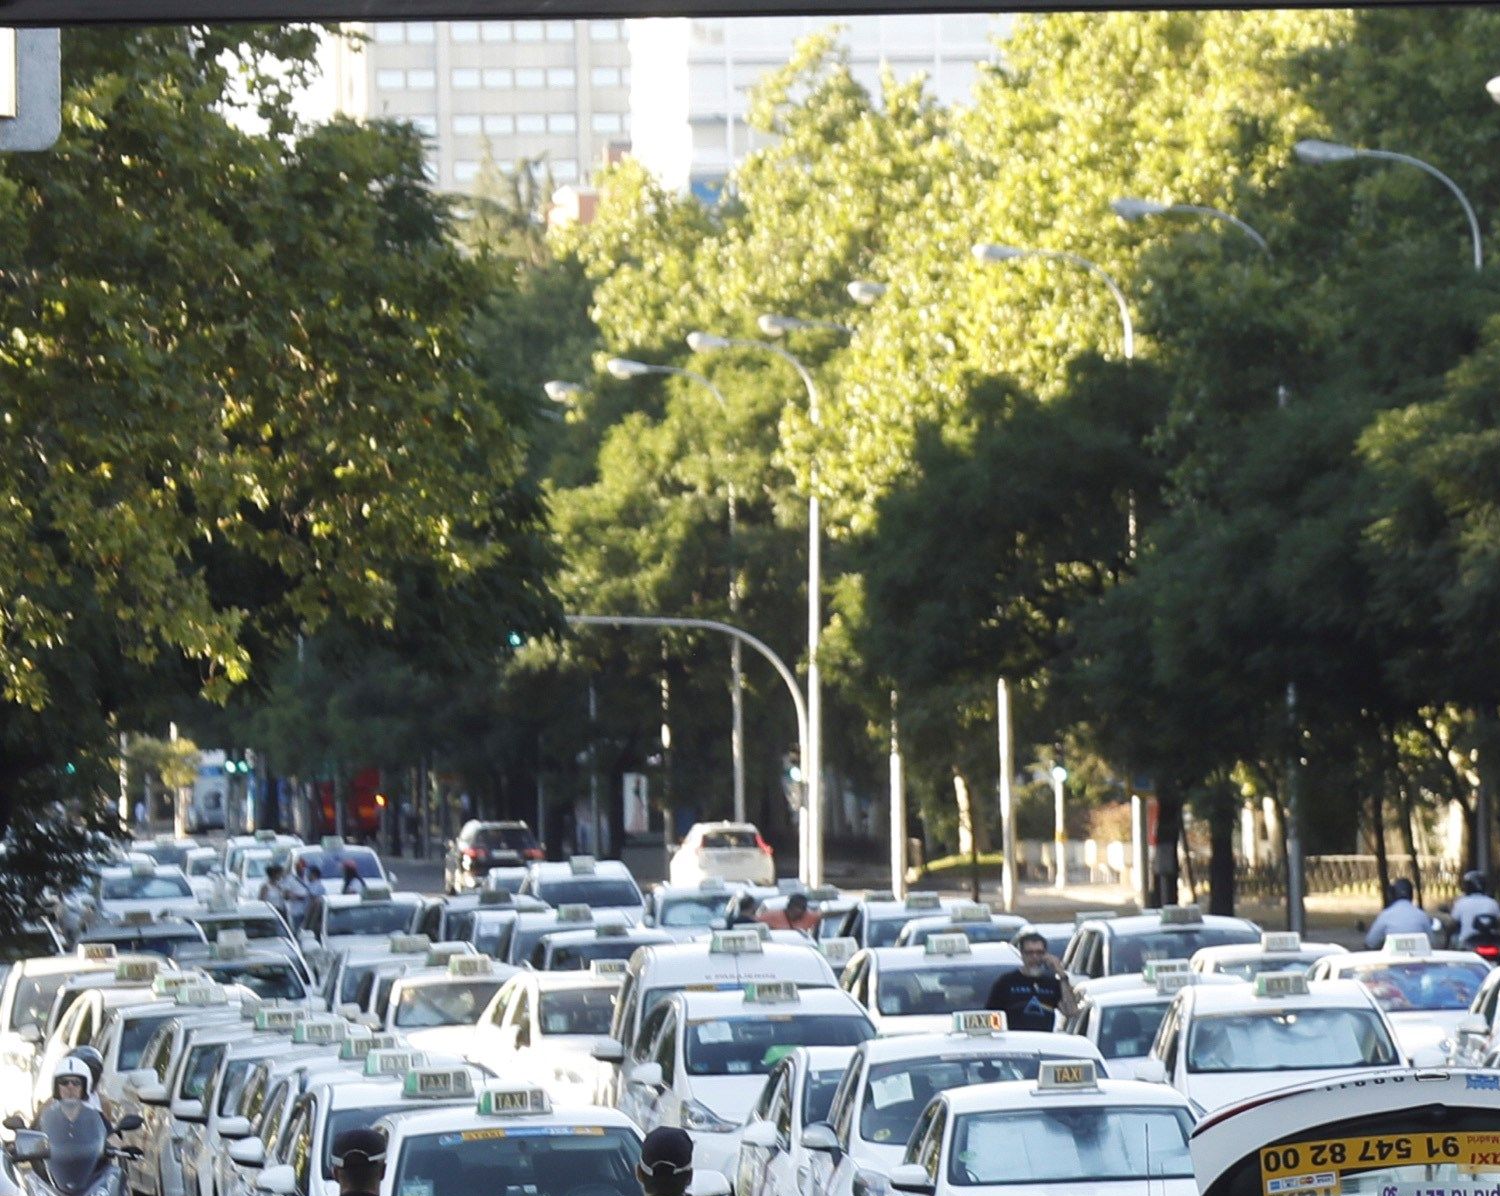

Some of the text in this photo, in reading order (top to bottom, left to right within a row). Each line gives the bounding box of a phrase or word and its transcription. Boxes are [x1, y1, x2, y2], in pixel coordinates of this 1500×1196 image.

[422, 1074, 449, 1089] TAXI
[1056, 1067, 1083, 1083] TAXI
[497, 1092, 526, 1108] TAXI
[1467, 1135, 1499, 1143] Madrid
[1264, 1136, 1460, 1173] 91 547 82 00
